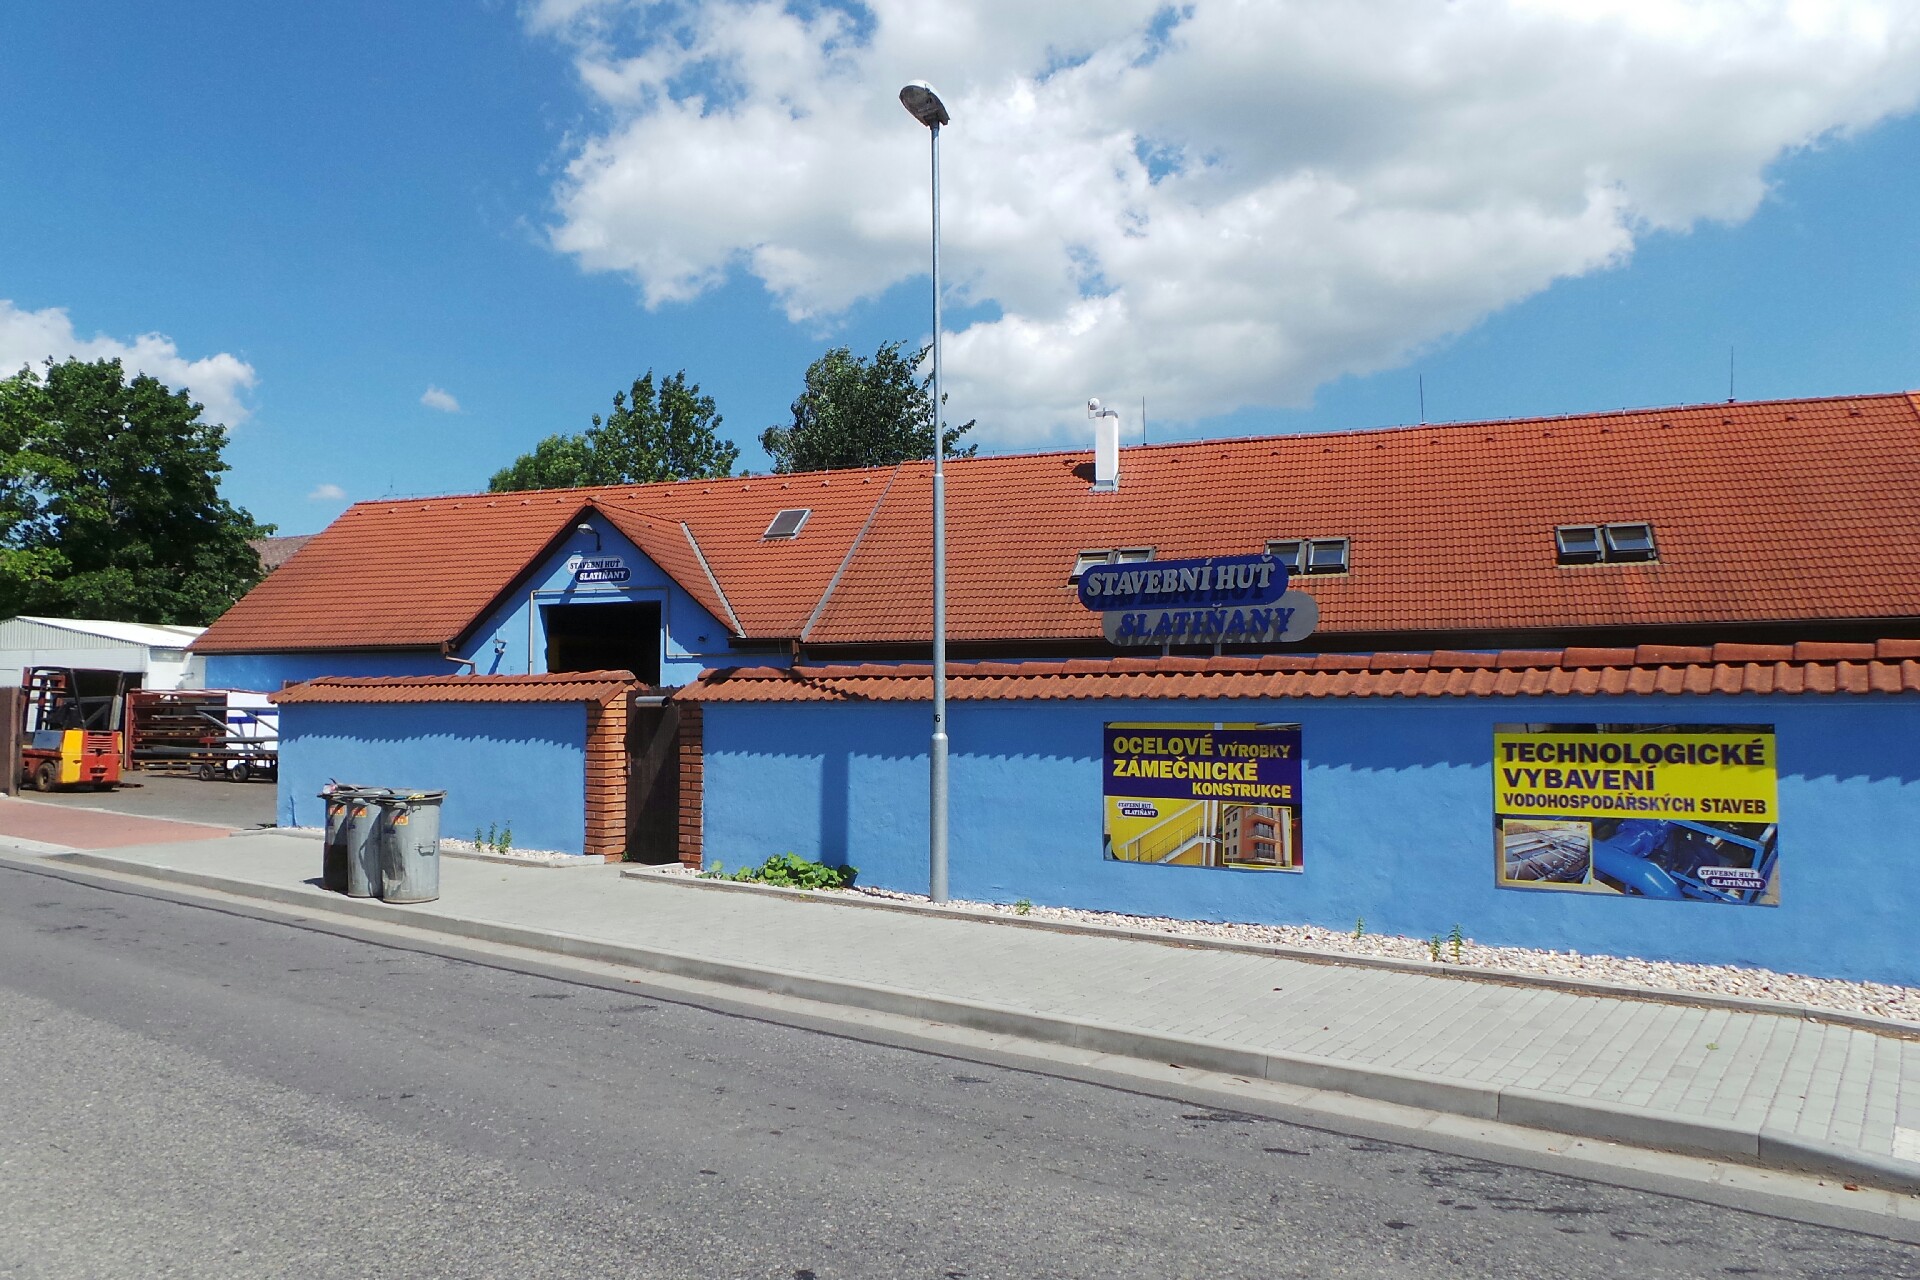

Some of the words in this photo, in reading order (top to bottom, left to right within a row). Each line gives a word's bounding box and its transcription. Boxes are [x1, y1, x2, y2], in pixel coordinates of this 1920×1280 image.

[569, 560, 603, 570] STAVEBNÍ
[579, 569, 626, 581] SLATIŇANY
[1086, 558, 1213, 597] STAVEBNÍ
[1215, 555, 1276, 591] HUŤ
[1118, 603, 1296, 638] SLATIŇANY
[1113, 733, 1214, 756] OCELOVÉ
[1218, 741, 1291, 759] VÝROBKY
[1501, 738, 1766, 766] TECHNOLOGICKÉ
[1113, 756, 1259, 781] ZÁMEČNICKÉ
[1503, 765, 1656, 791] VYBAVENÍ
[1192, 782, 1292, 799] KONSTRUKCE
[1503, 793, 1695, 813] VODOHOSPODÁŘSKÝCH
[1700, 798, 1767, 815] STAVEB
[1700, 869, 1737, 878] STAVEBNÍ
[1711, 878, 1762, 889] SLATIŇANY
